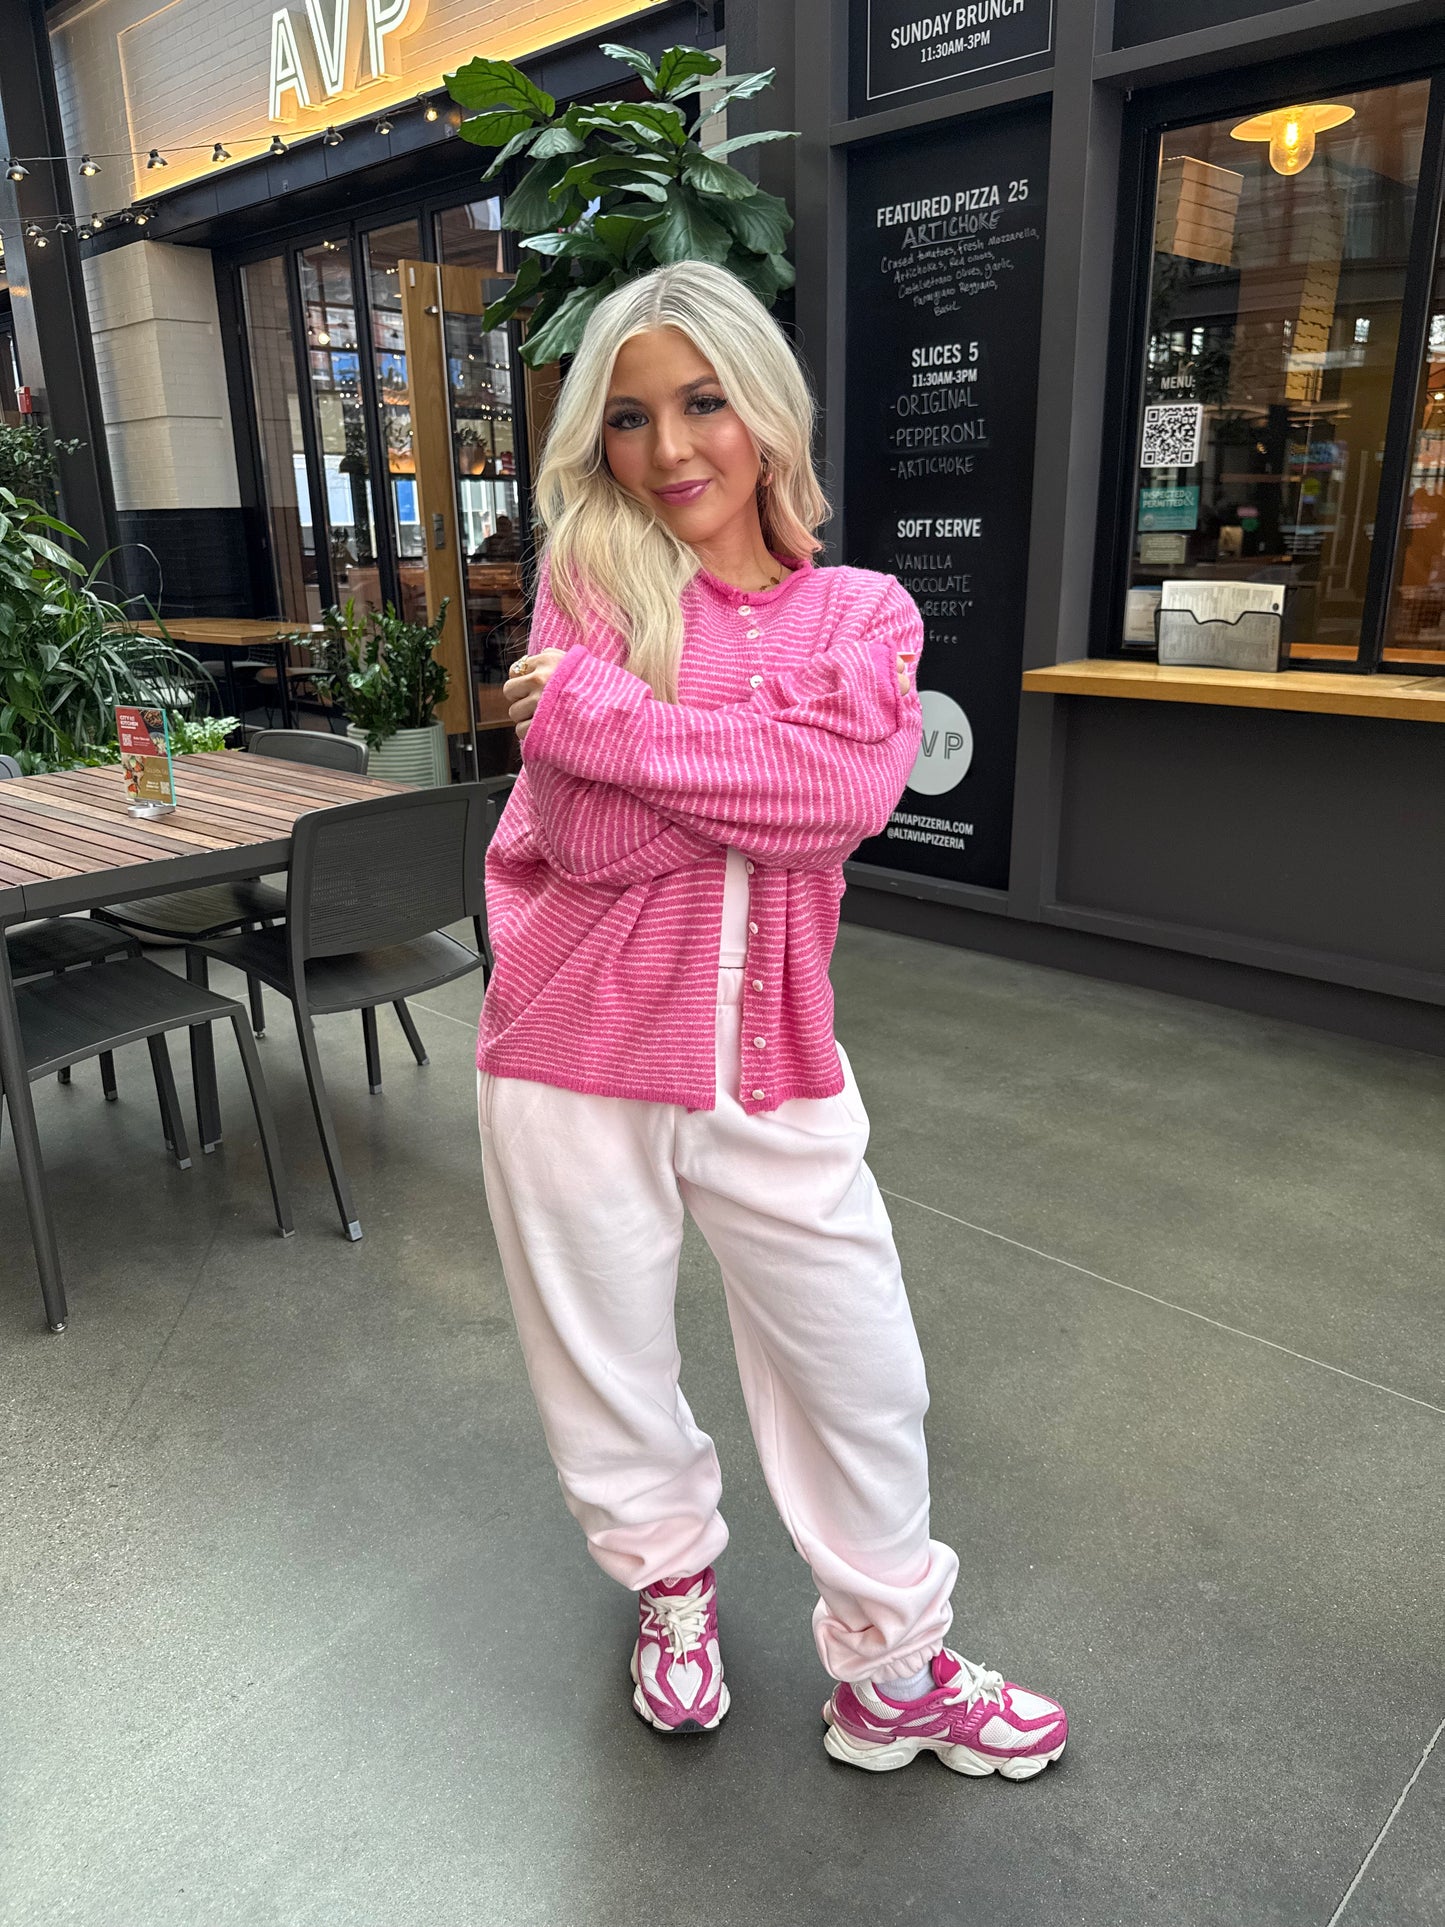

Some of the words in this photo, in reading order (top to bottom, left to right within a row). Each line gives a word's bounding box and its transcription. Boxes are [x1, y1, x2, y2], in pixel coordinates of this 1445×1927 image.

[890, 11, 952, 49] SUNDAY
[956, 0, 1024, 30] BRUNCH
[920, 30, 991, 63] 11:30AM-3PM
[268, 0, 411, 121] AVP
[877, 195, 951, 228] FEATURED
[955, 185, 1000, 213] PIZZA
[1008, 179, 1029, 203] 25
[901, 209, 1003, 250] ARTICHOKE
[911, 344, 961, 368] SLICES
[968, 342, 979, 362] 5
[911, 368, 978, 387] 11:30AM-3PM
[1160, 376, 1196, 390] MENU:
[897, 520, 932, 538] SOFT
[935, 518, 982, 537] SERVE
[897, 575, 972, 593] HOCOLATE
[922, 730, 964, 760] VP
[888, 812, 974, 835] TAVIAPIZZERIA.COM
[887, 827, 965, 850] @ALTAVIAPIZZERIA
